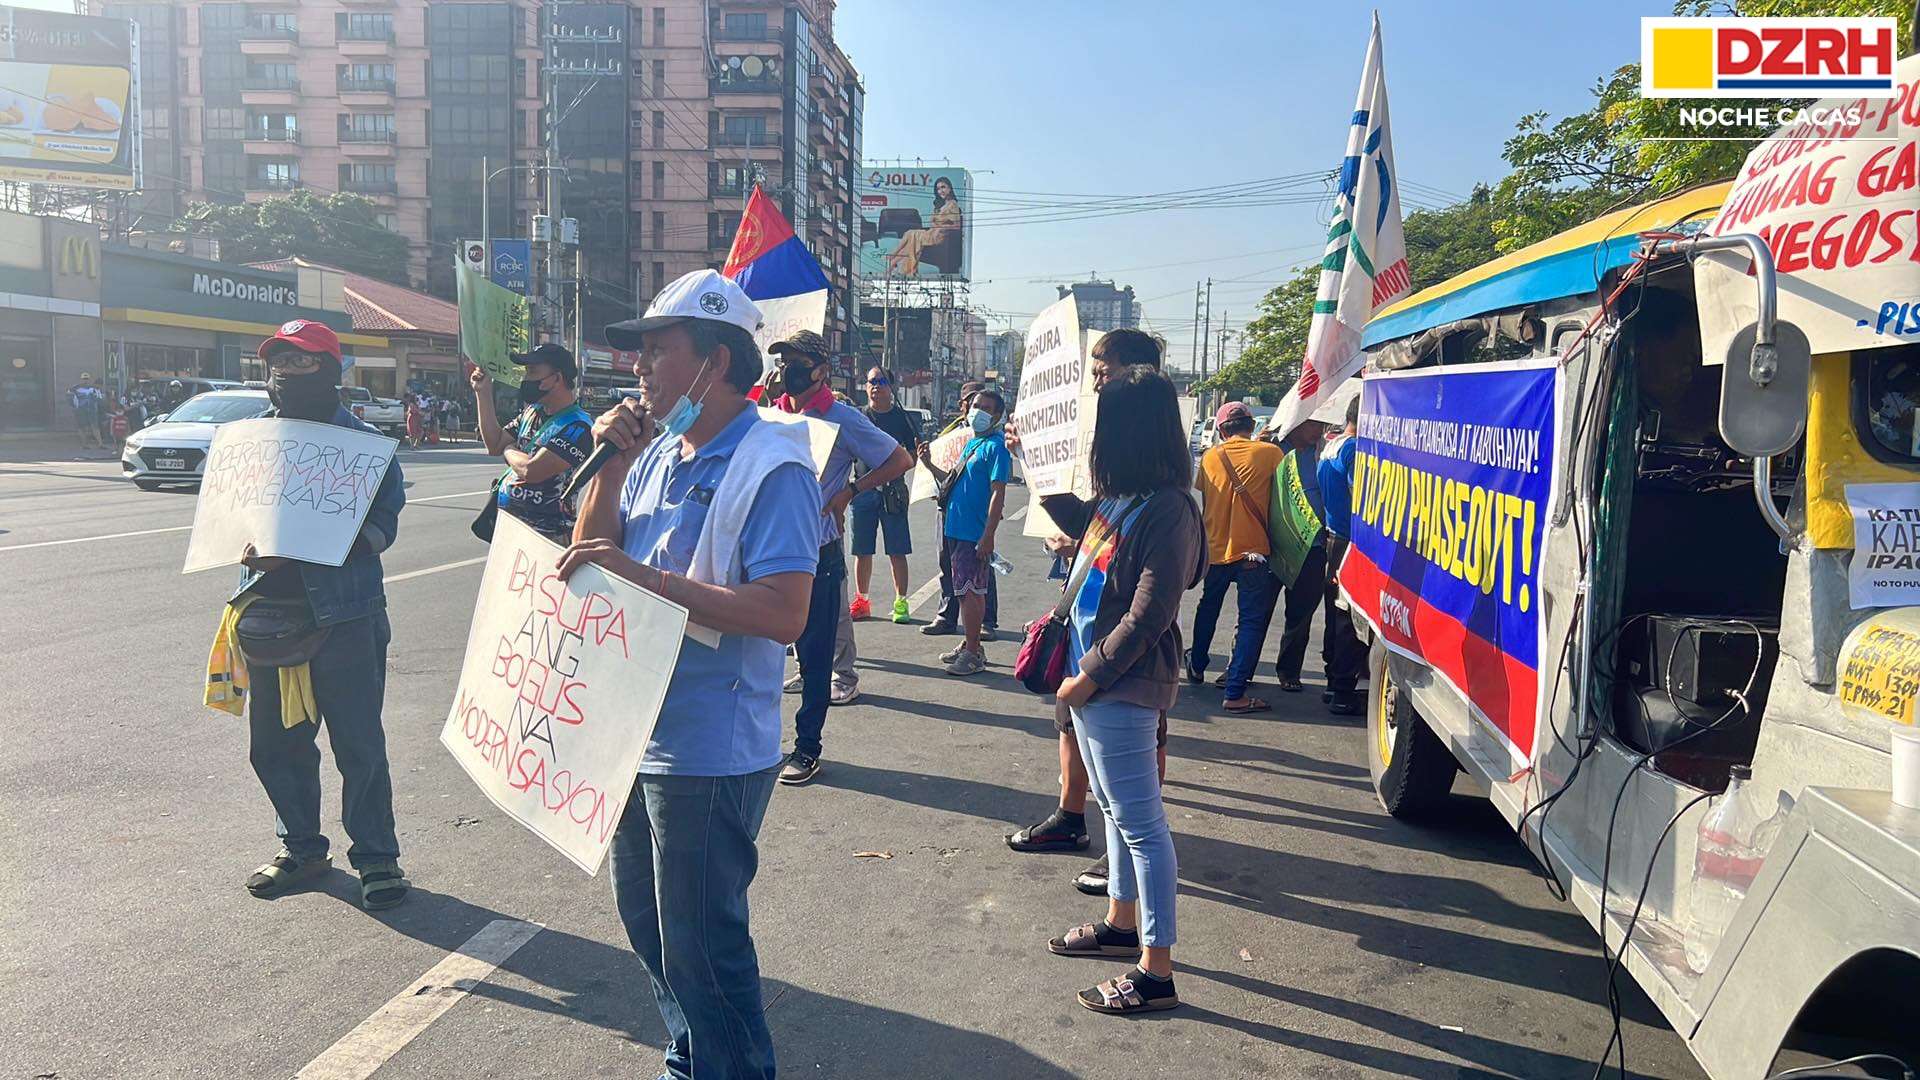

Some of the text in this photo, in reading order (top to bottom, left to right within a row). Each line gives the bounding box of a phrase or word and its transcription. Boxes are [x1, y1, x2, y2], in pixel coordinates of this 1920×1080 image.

[884, 173, 930, 186] JOLLY
[1714, 155, 1846, 237] HUWAG
[500, 263, 524, 271] RCBC
[506, 280, 524, 288] ATM
[193, 273, 296, 306] McDonald's
[1030, 359, 1080, 397] OMNIBUS
[570, 446, 587, 462] OPS
[1418, 419, 1459, 459] PRANGKISA
[1459, 424, 1472, 462] AT
[1470, 426, 1540, 474] KABUHAYAN!
[511, 485, 543, 505] OPS
[1352, 451, 1366, 515] NO
[1362, 454, 1379, 525] TO
[1374, 460, 1408, 542] PUV
[1405, 469, 1536, 613] PHASEOUT!
[509, 548, 629, 660] BASURA
[514, 610, 583, 678] ANG
[492, 634, 587, 725] BOGUS
[1885, 695, 1906, 719] 21
[506, 697, 556, 764] NA
